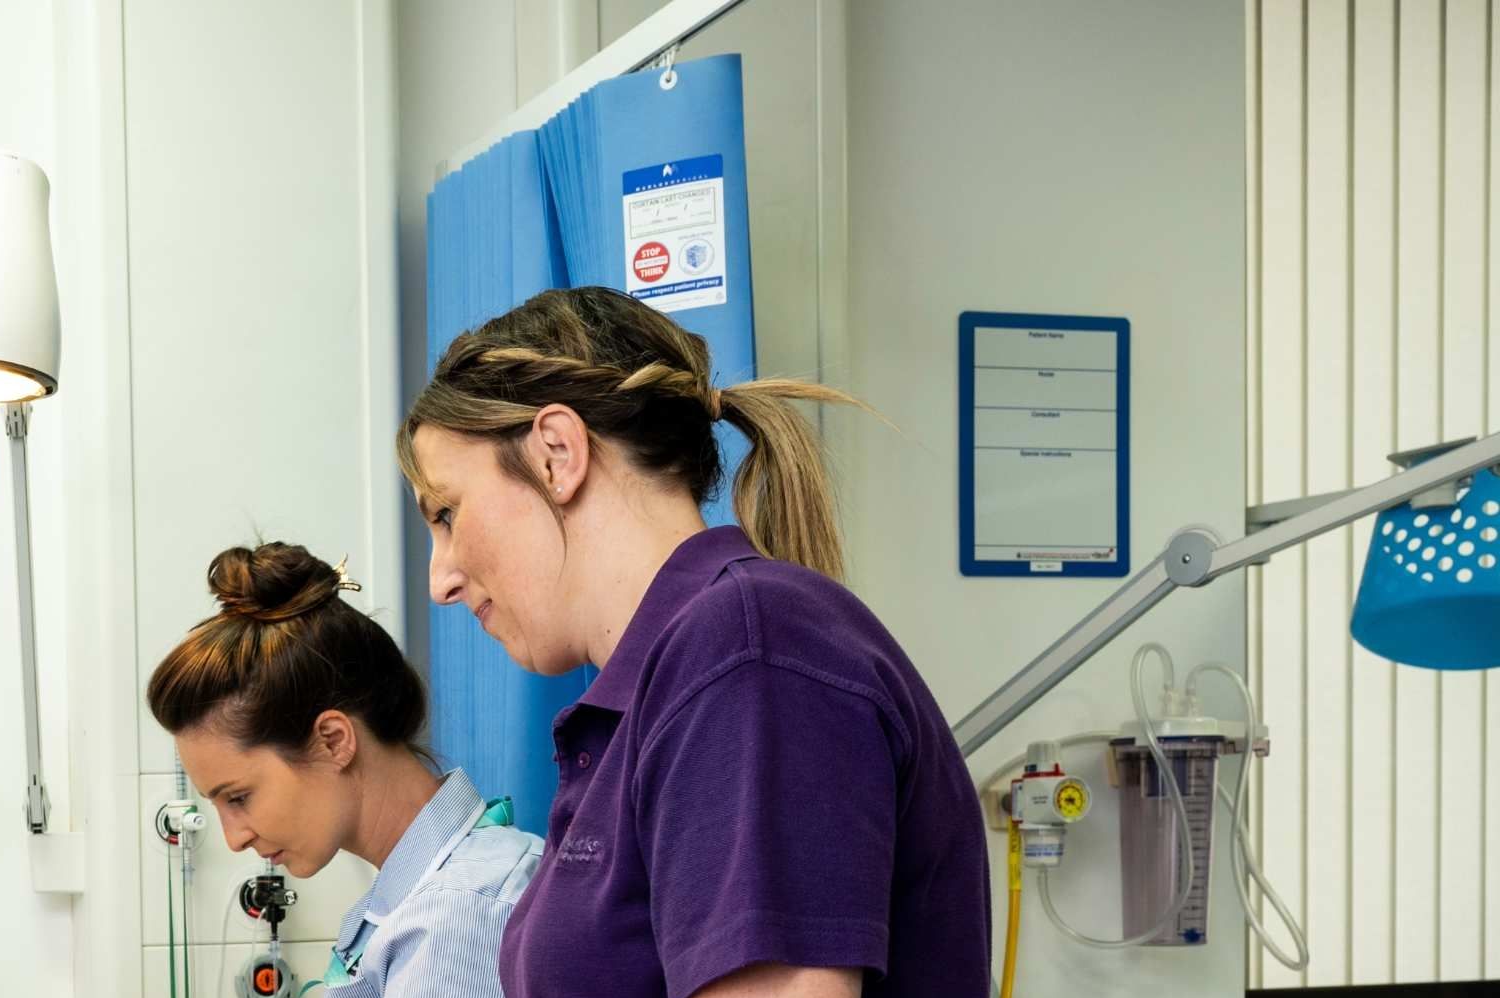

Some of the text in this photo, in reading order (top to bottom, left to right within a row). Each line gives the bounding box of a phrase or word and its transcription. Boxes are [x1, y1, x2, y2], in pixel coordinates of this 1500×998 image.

[641, 248, 661, 258] STOP
[640, 266, 664, 278] THINK
[632, 278, 720, 298] Please respect patient privacy
